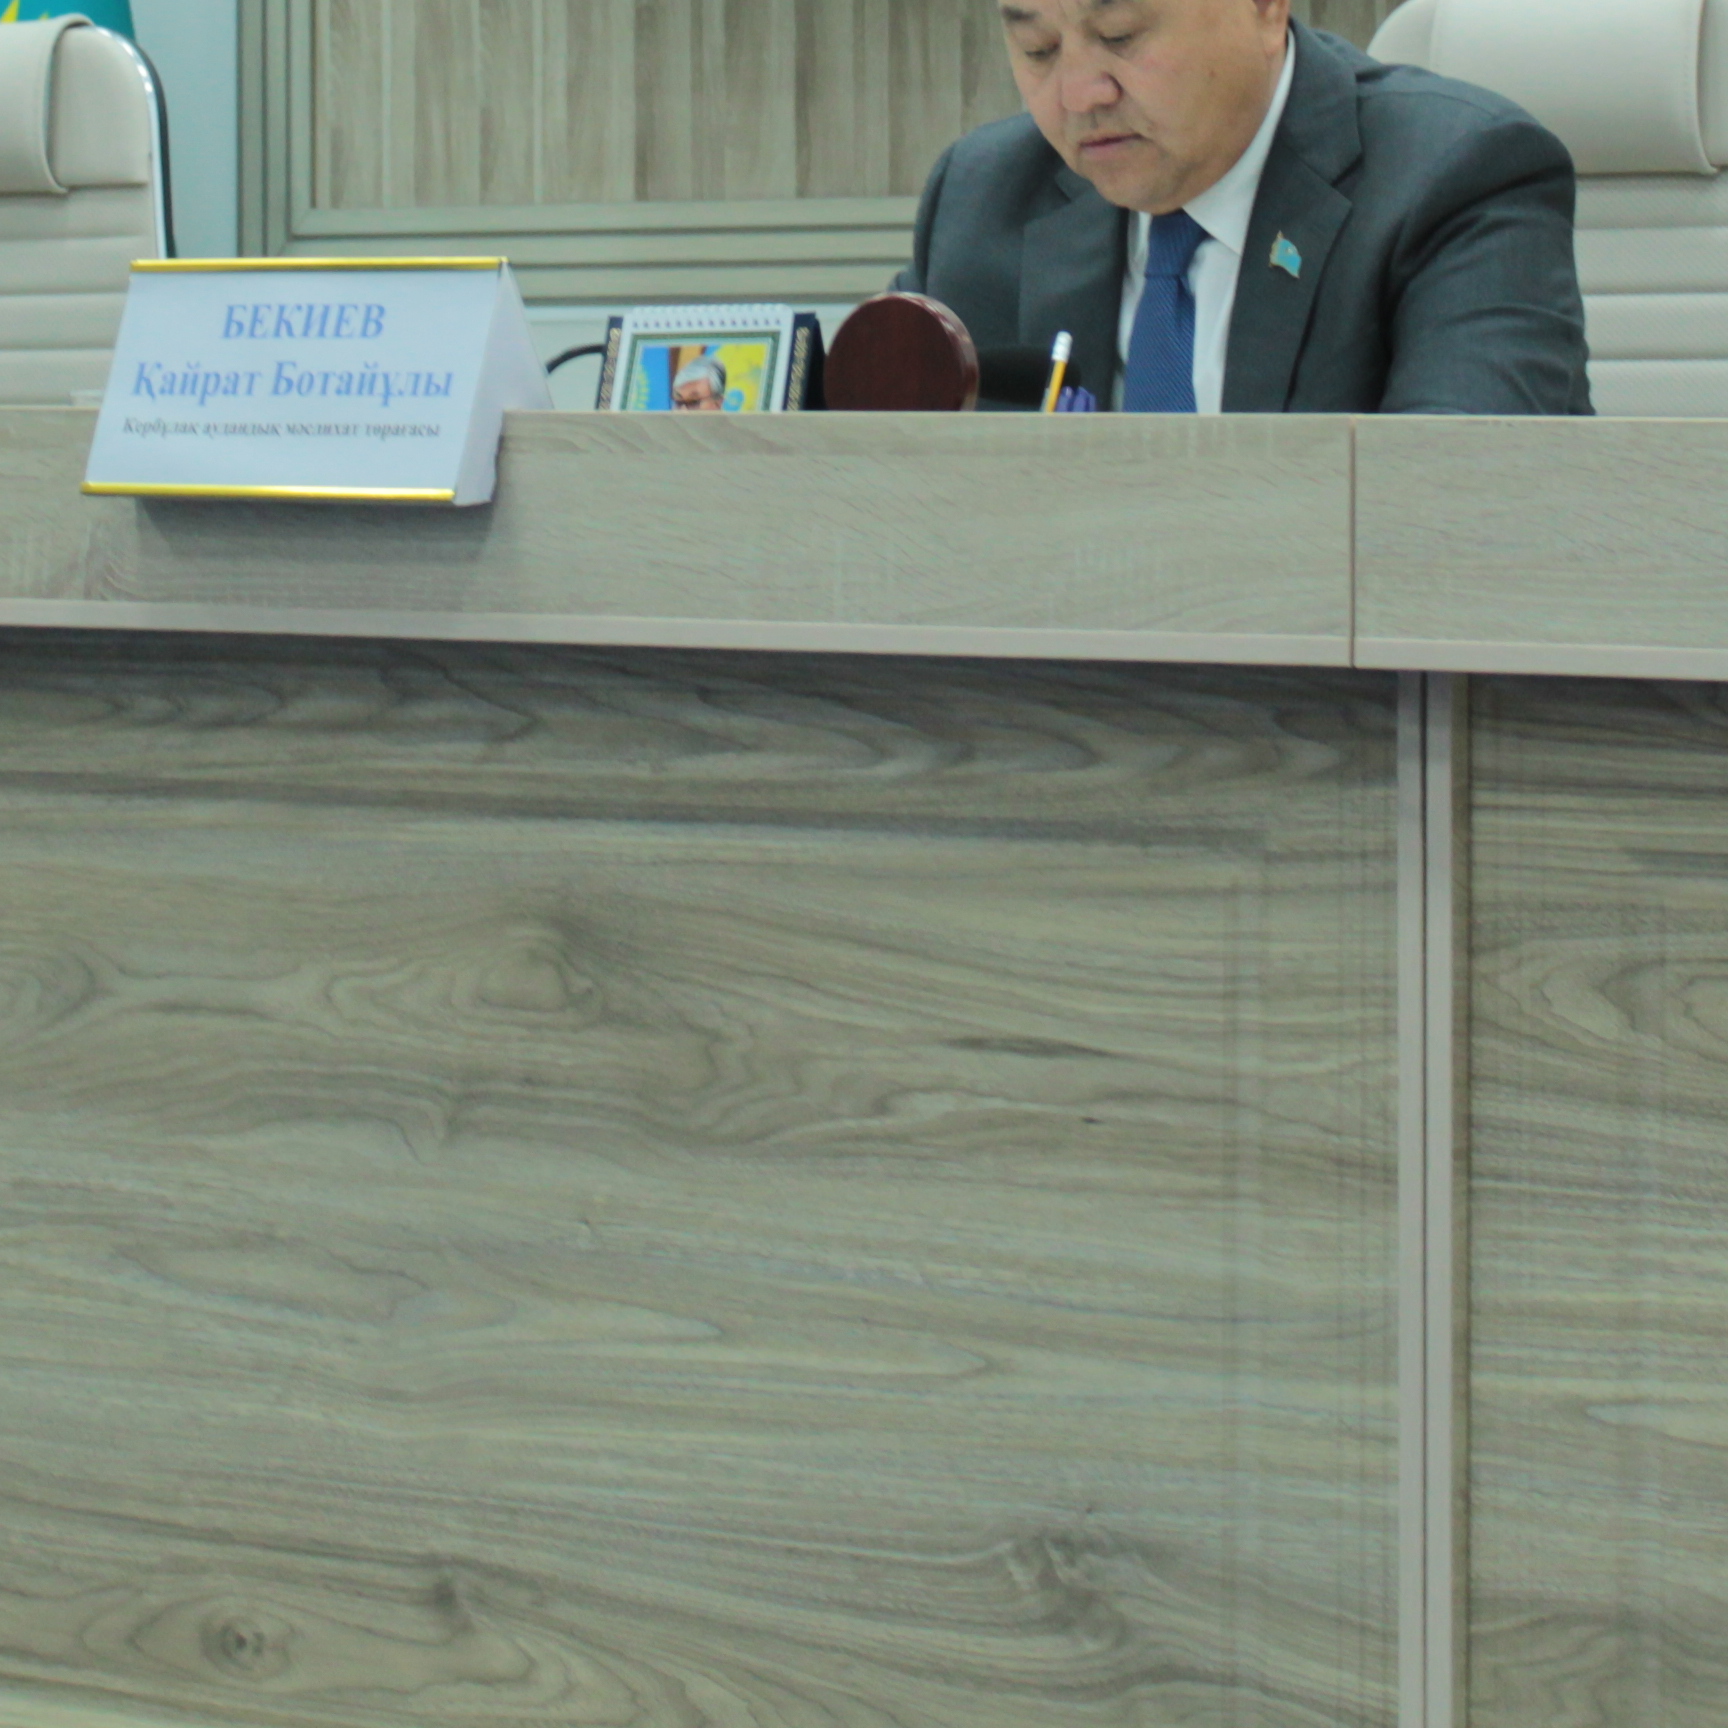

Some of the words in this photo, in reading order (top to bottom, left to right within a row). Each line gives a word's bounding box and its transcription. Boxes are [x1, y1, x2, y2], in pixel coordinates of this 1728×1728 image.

[221, 303, 388, 340] БЕКИЕВ
[131, 360, 262, 407] Қайрат
[271, 360, 454, 407] Ботайұлы
